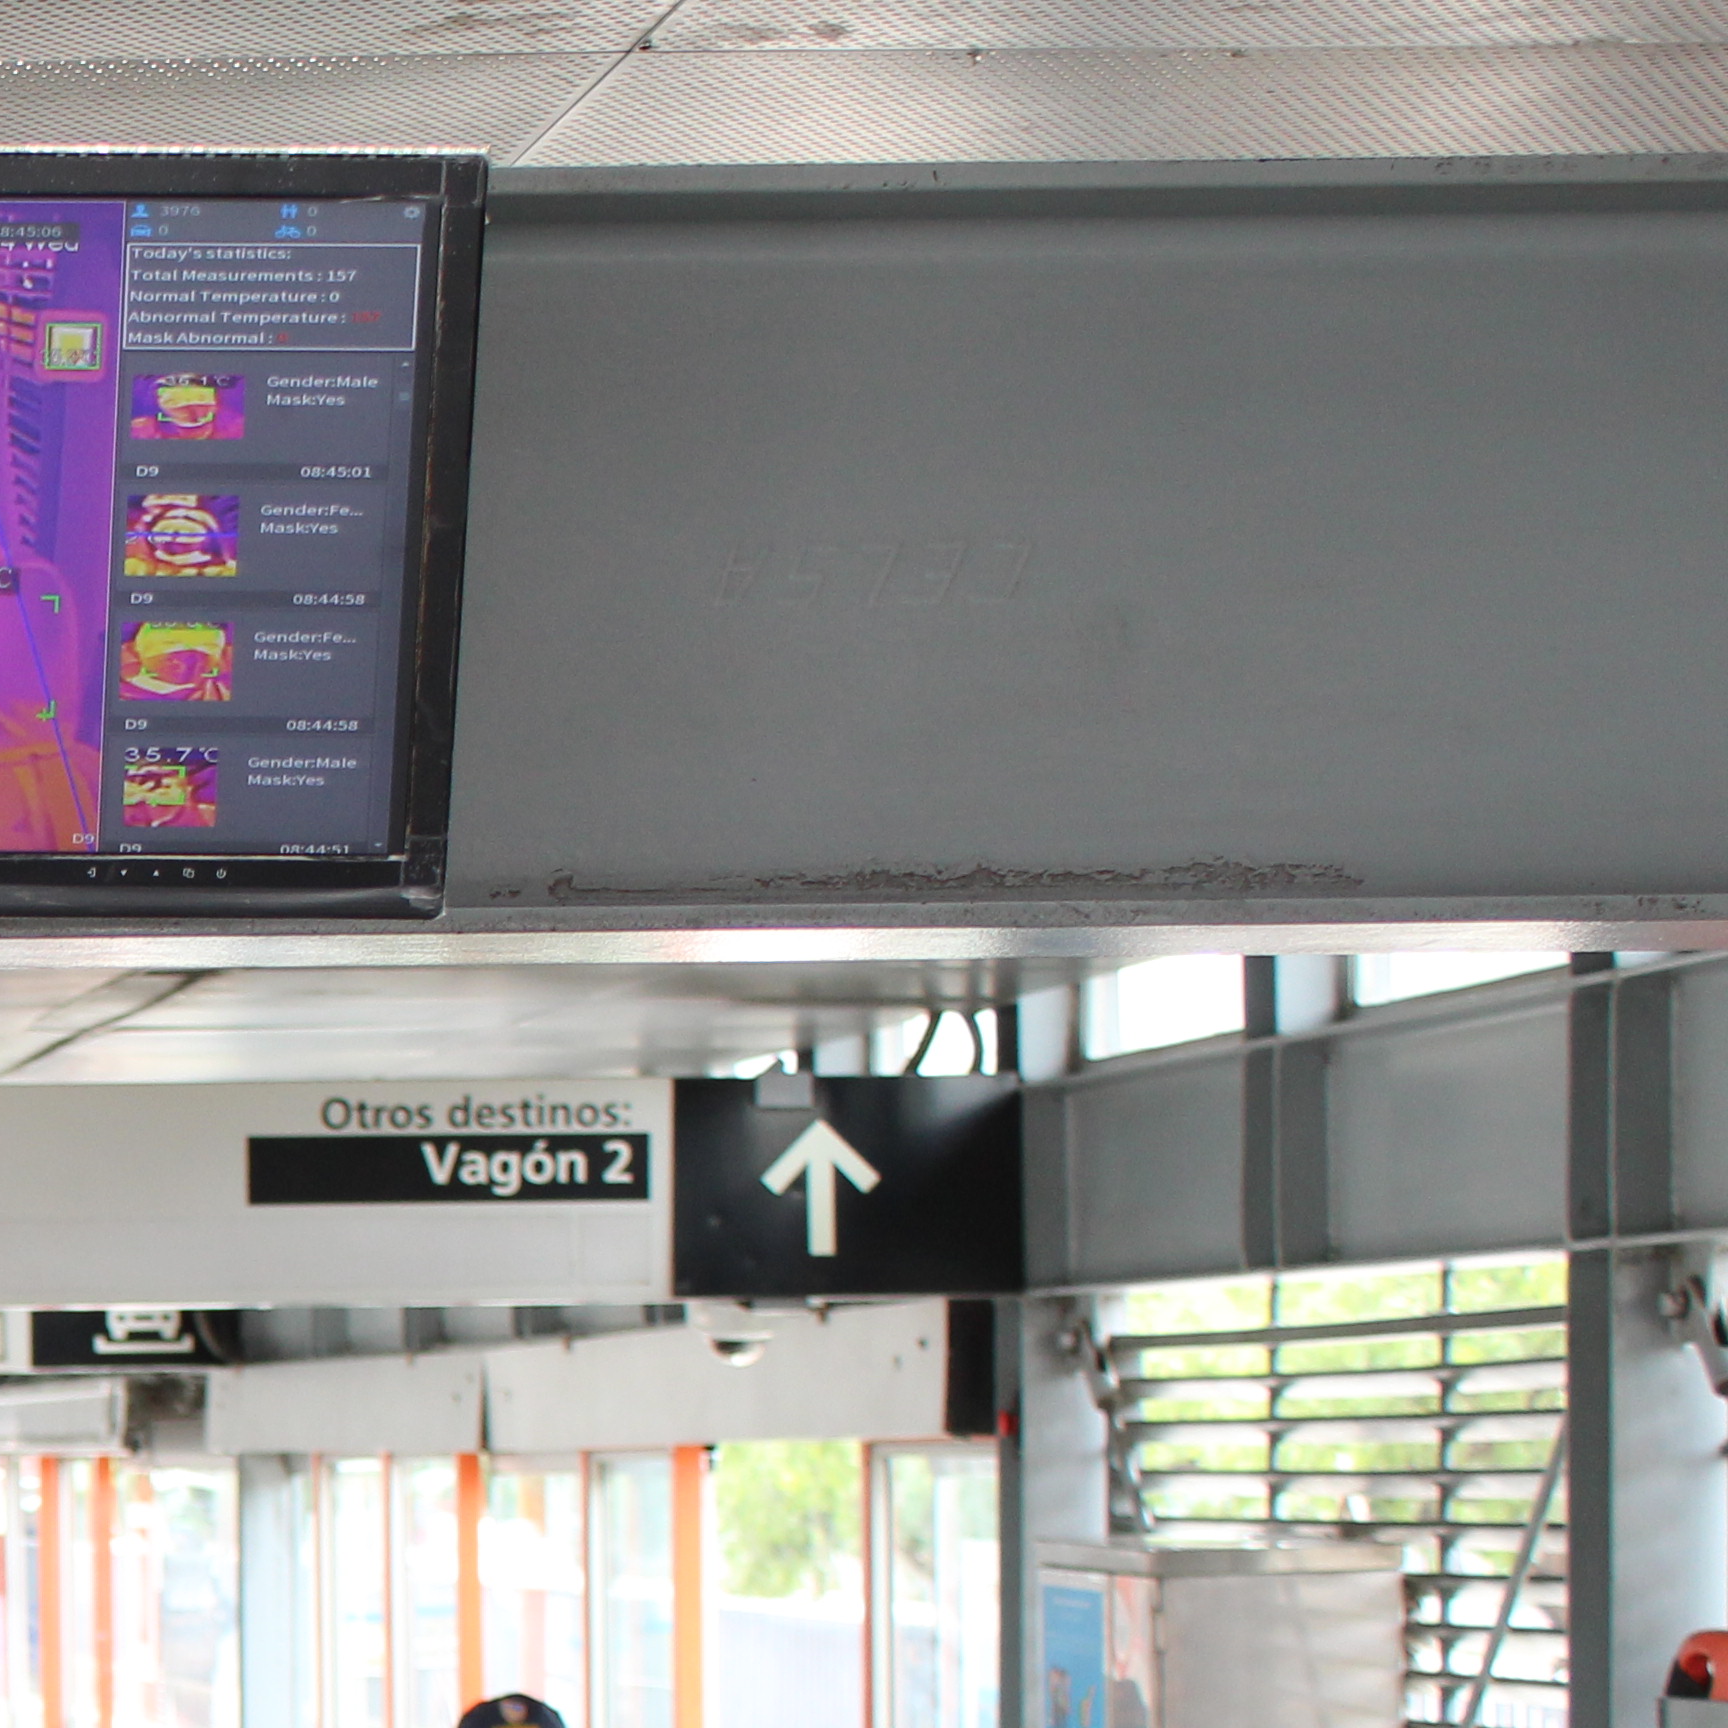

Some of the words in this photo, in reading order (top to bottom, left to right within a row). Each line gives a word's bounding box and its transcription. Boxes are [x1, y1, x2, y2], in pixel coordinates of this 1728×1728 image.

[131, 247, 202, 262] Today's
[205, 248, 292, 261] statistics:
[131, 270, 177, 282] Total
[328, 270, 357, 283] 157
[129, 291, 195, 303] Normal
[329, 291, 340, 303] 0
[128, 312, 216, 324] Abnormal
[128, 332, 173, 344] Mask
[266, 376, 379, 388] Gender:Male
[266, 394, 346, 407] Mask:Yes
[135, 465, 160, 478] D9
[299, 466, 372, 479] 08:45:01
[260, 522, 339, 535] Mask:Yes
[130, 593, 154, 605] D9
[292, 593, 366, 606] 08:44:58
[253, 649, 332, 662] Mask:Yes
[124, 718, 148, 731] D9
[286, 719, 359, 731] 08:44:58
[247, 757, 358, 770] Gender:Male
[247, 774, 326, 787] Mask:Yes
[321, 1096, 434, 1130] Otros
[447, 1093, 632, 1129] destinos:
[420, 1138, 589, 1197] Vagón
[600, 1138, 634, 1185] 2
